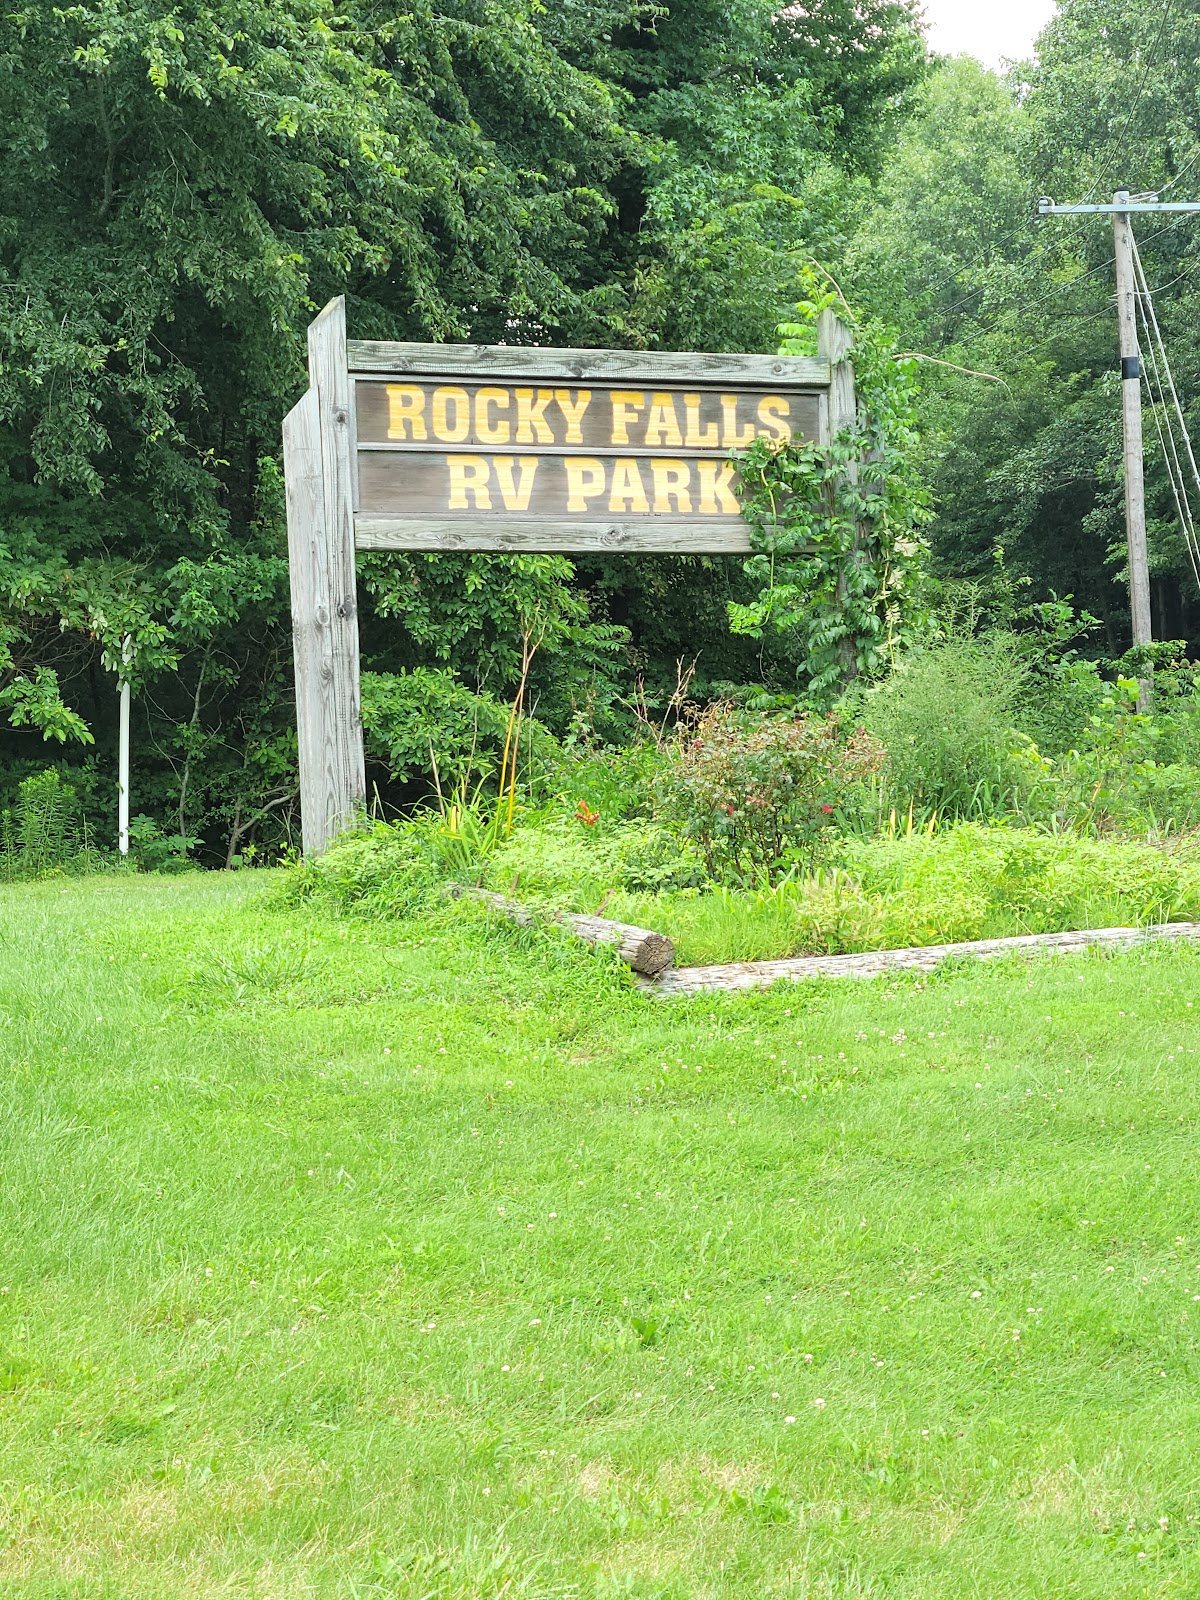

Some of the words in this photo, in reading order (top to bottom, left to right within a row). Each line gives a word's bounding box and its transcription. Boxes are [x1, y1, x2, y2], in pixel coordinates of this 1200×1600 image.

[386, 383, 592, 444] ROCKY
[610, 391, 792, 450] FALLS
[446, 455, 538, 511] RV
[564, 457, 742, 514] PARK
